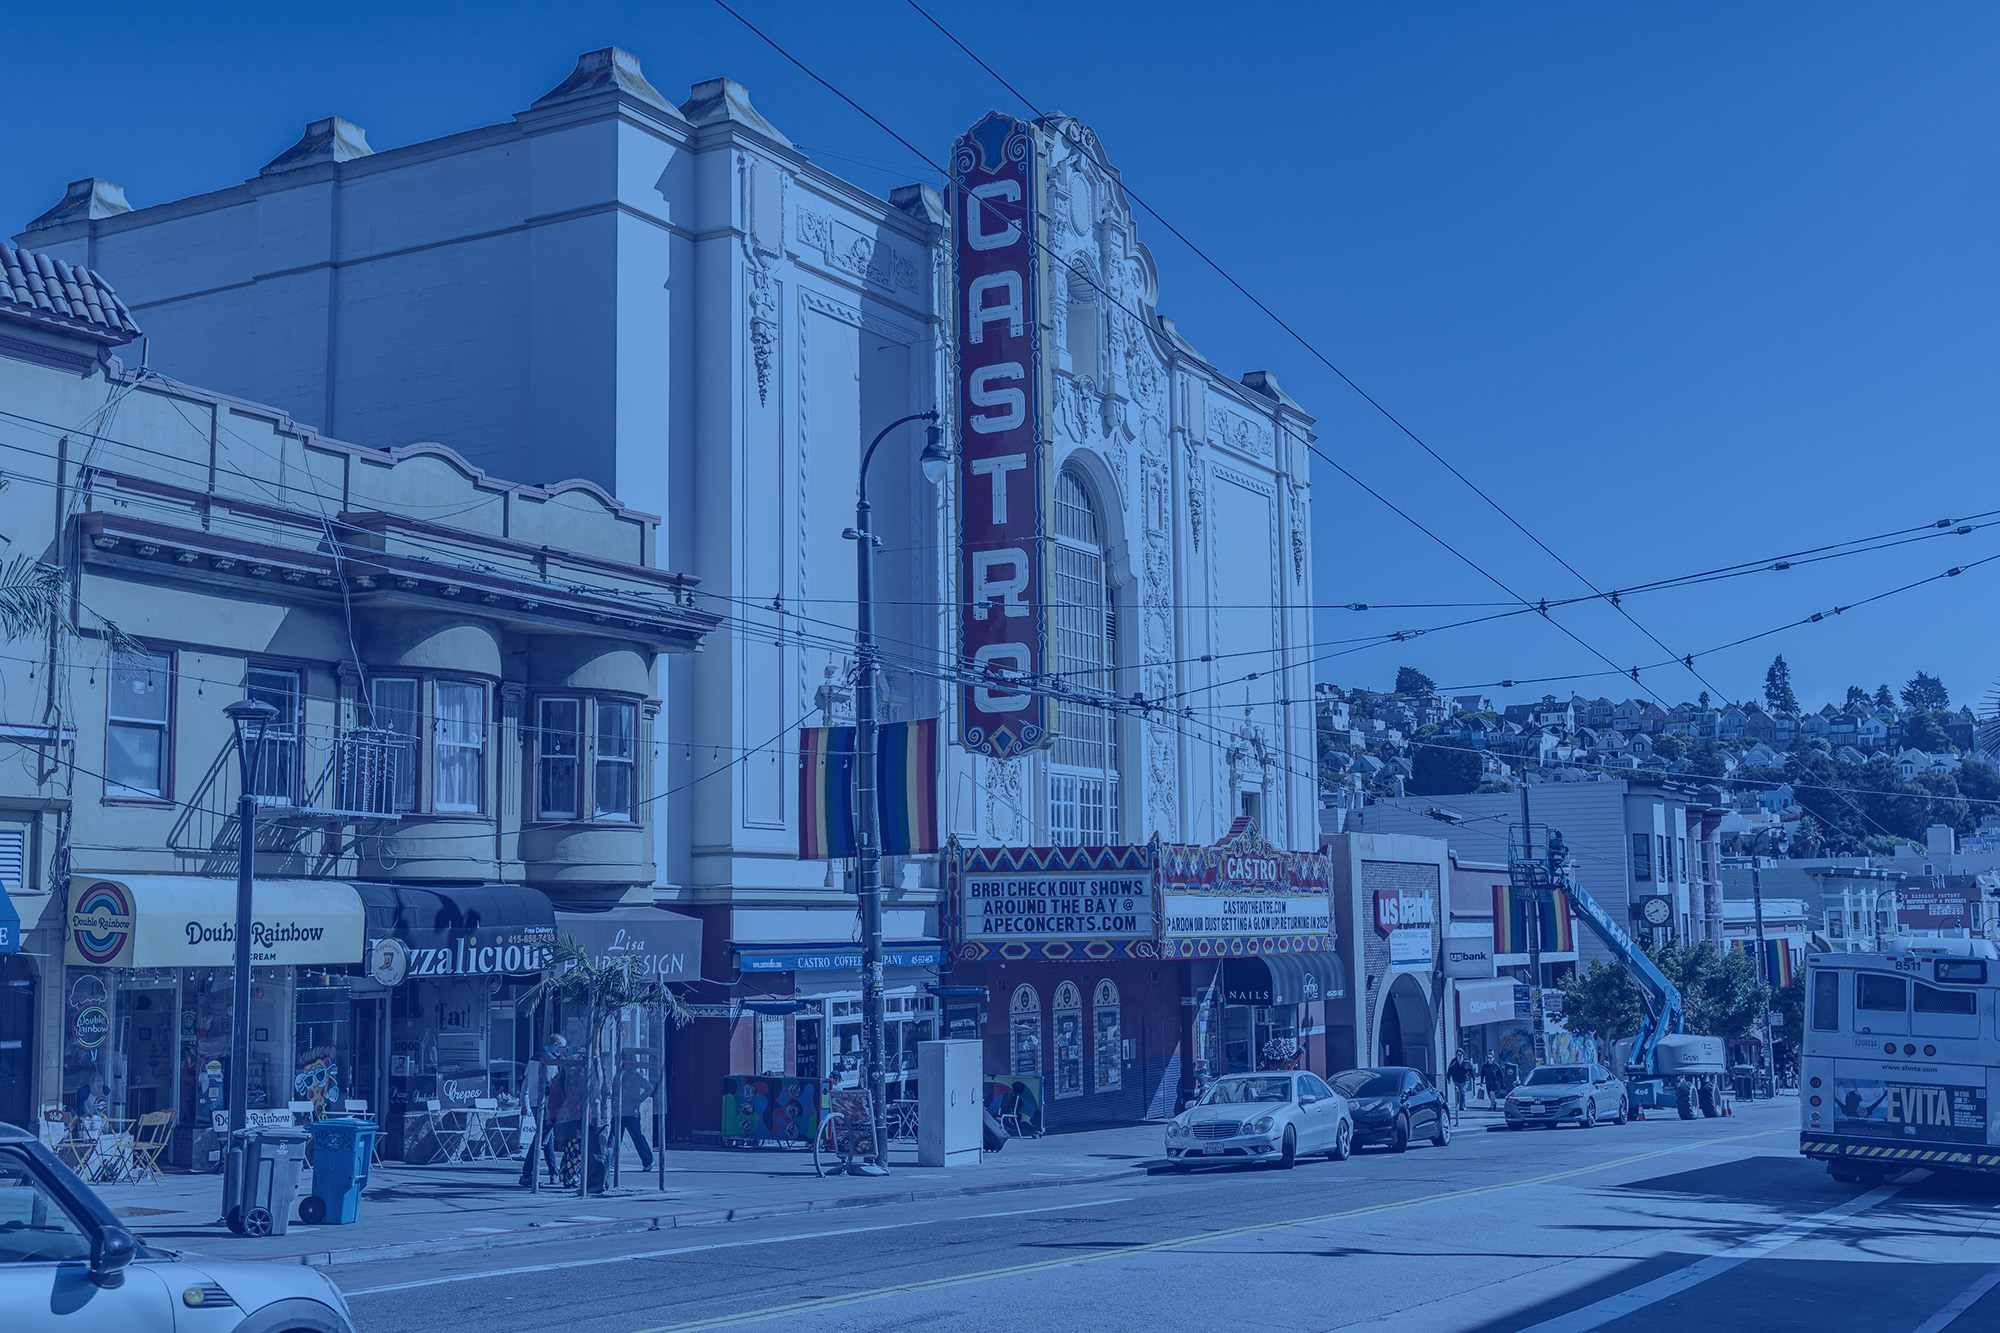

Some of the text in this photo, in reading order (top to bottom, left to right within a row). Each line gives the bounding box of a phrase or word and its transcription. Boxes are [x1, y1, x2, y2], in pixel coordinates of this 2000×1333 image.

[966, 178, 1032, 714] CASTRO
[1227, 857, 1277, 881] CASTRO
[971, 882, 1005, 897] BRB!
[1091, 880, 1144, 896] SHOWS
[983, 899, 1047, 915] AROUND
[1050, 899, 1080, 914] THE
[1085, 898, 1118, 913] BAY
[1223, 901, 1287, 915] CASTROTHEATRE.COM
[1588, 897, 1608, 927] Genie
[73, 915, 130, 930] Double Rainbow
[983, 916, 1137, 933] APECONCERTS.COM
[1166, 917, 1194, 932] PARDON
[1205, 917, 1220, 931] DUST
[1221, 917, 1248, 931] GETTING
[1253, 917, 1271, 930] GLOW
[186, 921, 324, 948] Doubl Rainbow
[607, 928, 646, 951] Lisa
[369, 937, 554, 976] zzalicious
[797, 957, 831, 968] CASTRO
[834, 955, 863, 967] COFFEE
[881, 954, 903, 965] PANY
[1895, 961, 1921, 971] 8511
[1229, 991, 1269, 1000] NAILS
[80, 1014, 106, 1026] Double
[74, 1024, 109, 1037] Rainbow
[1881, 1065, 1938, 1073] www.sfmta.com
[443, 1079, 482, 1104] Crepes
[1634, 1088, 1649, 1096] 4x4
[1887, 1087, 1951, 1126] EVITA
[215, 1112, 290, 1128] Doe Rainbow
